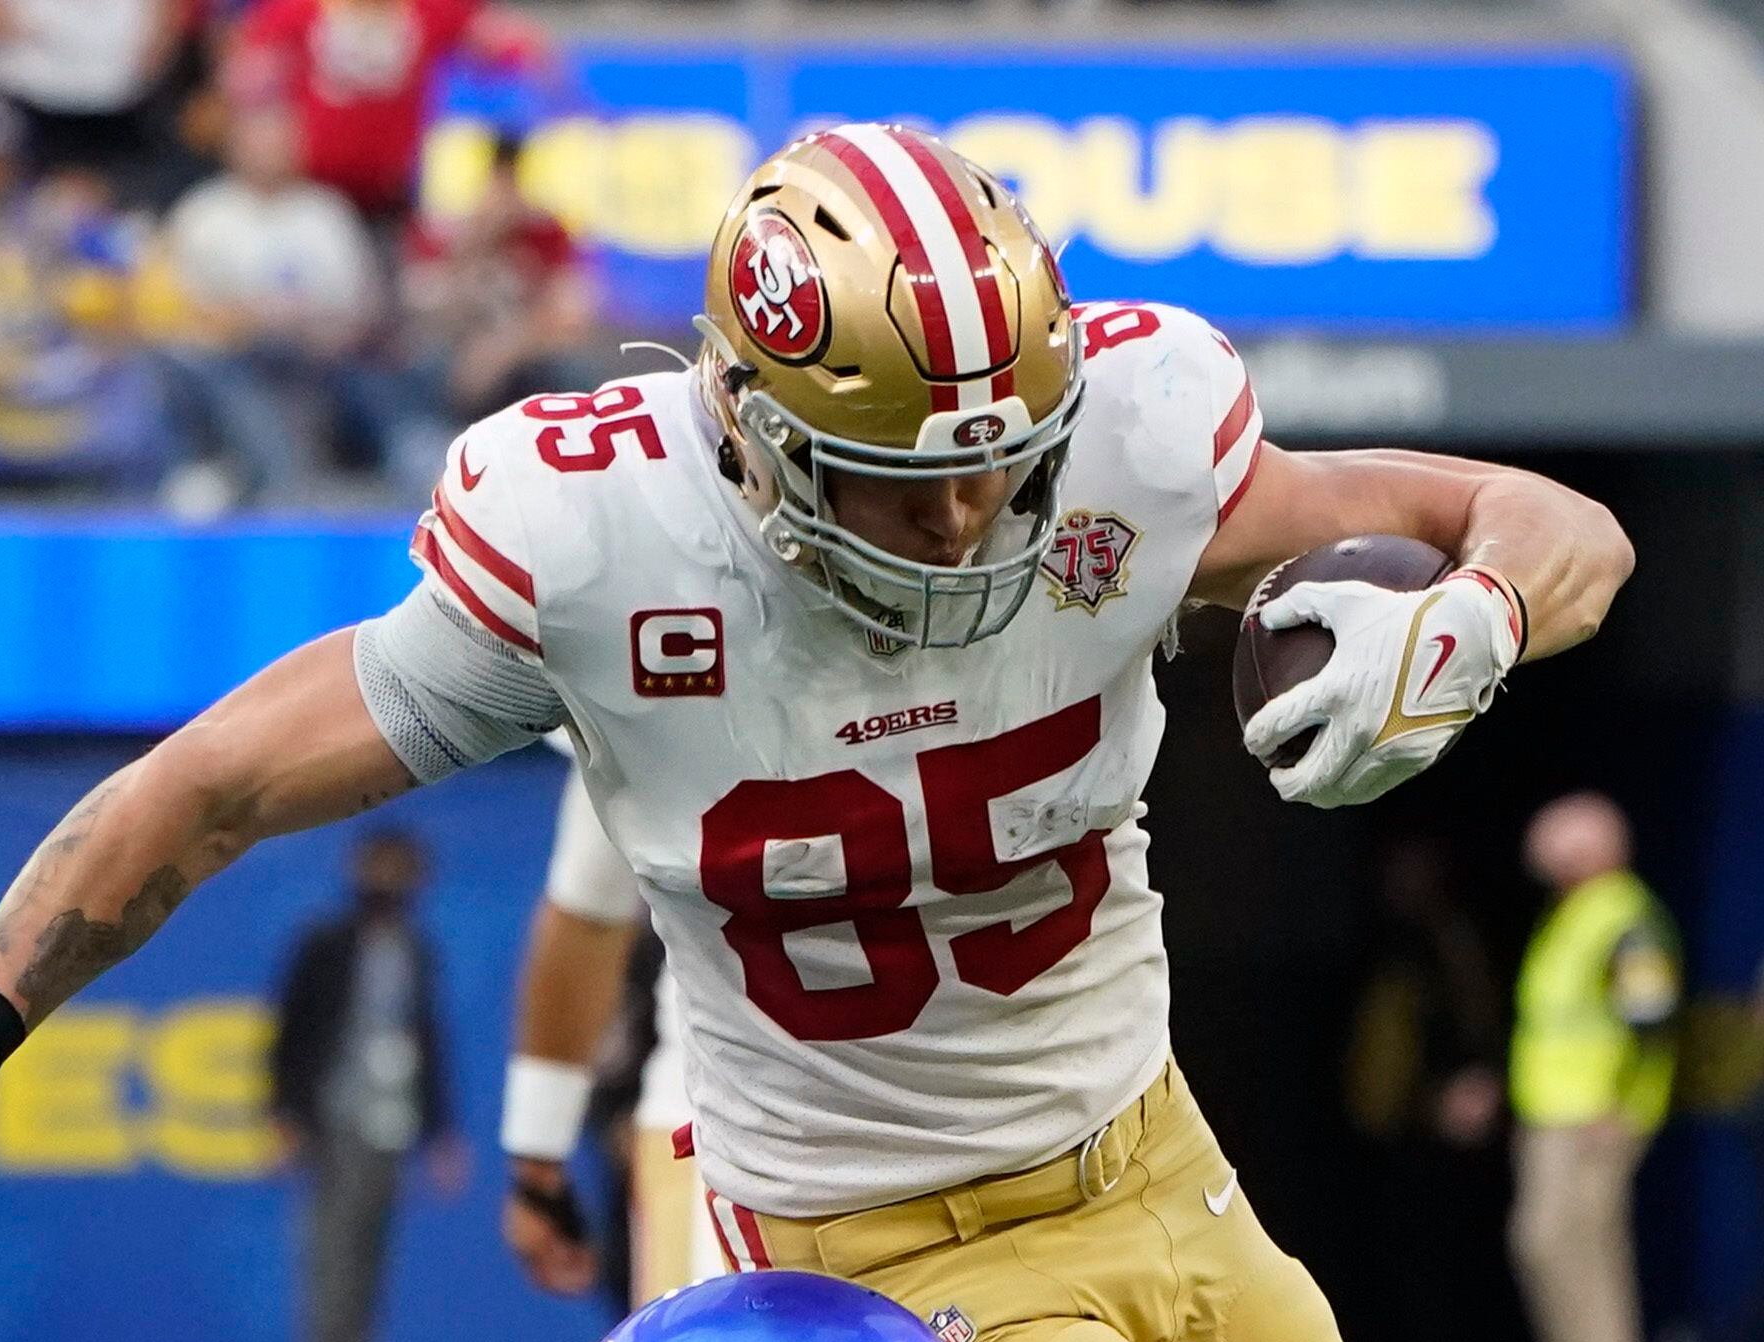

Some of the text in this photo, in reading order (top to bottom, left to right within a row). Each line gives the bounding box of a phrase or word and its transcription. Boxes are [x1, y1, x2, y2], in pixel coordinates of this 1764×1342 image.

[521, 386, 667, 472] 85
[1053, 528, 1116, 584] 75
[638, 614, 717, 674] C
[835, 700, 958, 745] 49ERS
[699, 693, 1113, 1042] 85
